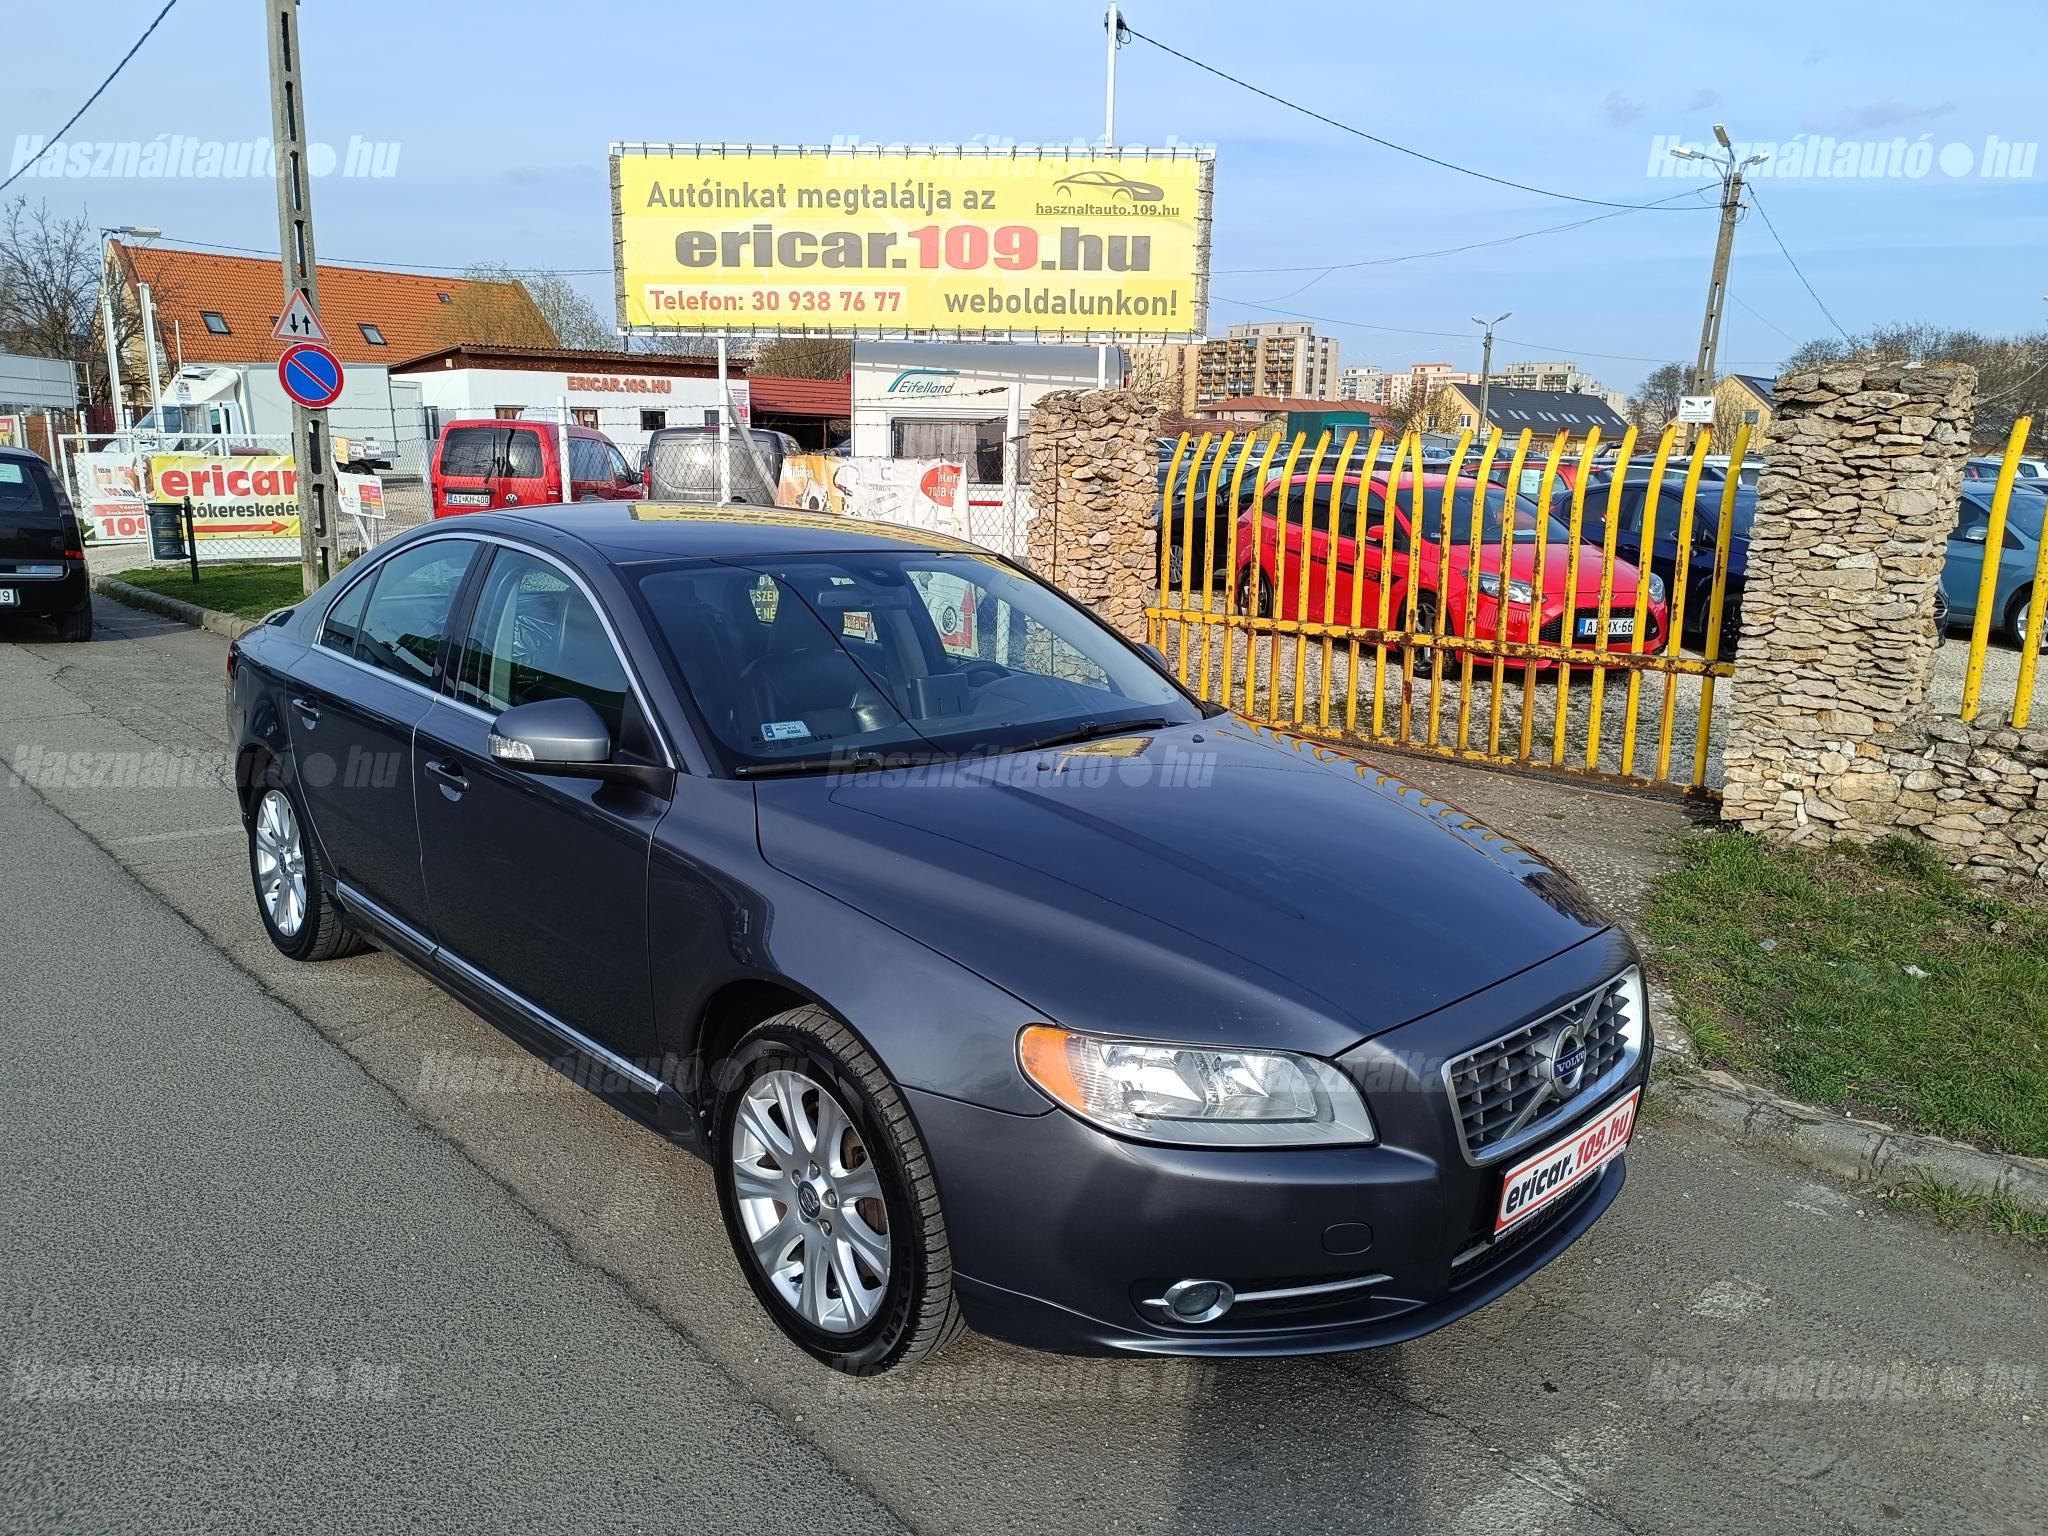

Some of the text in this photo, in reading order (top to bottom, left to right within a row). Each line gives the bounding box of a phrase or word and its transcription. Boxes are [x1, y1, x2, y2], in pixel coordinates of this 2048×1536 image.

[647, 178, 996, 216] Autóinkat megtalálja az
[1036, 202, 1180, 217] hasznaltauto.109.hu
[675, 224, 1151, 272] ericar.109.hu
[650, 289, 901, 312] Telefon: 30 938 76 77
[944, 287, 1177, 316] weboldalunkon!
[567, 376, 672, 394] ERICAR.109.HU
[899, 381, 956, 393] Eifelland
[1505, 1111, 1631, 1215] ericar.109.hu
